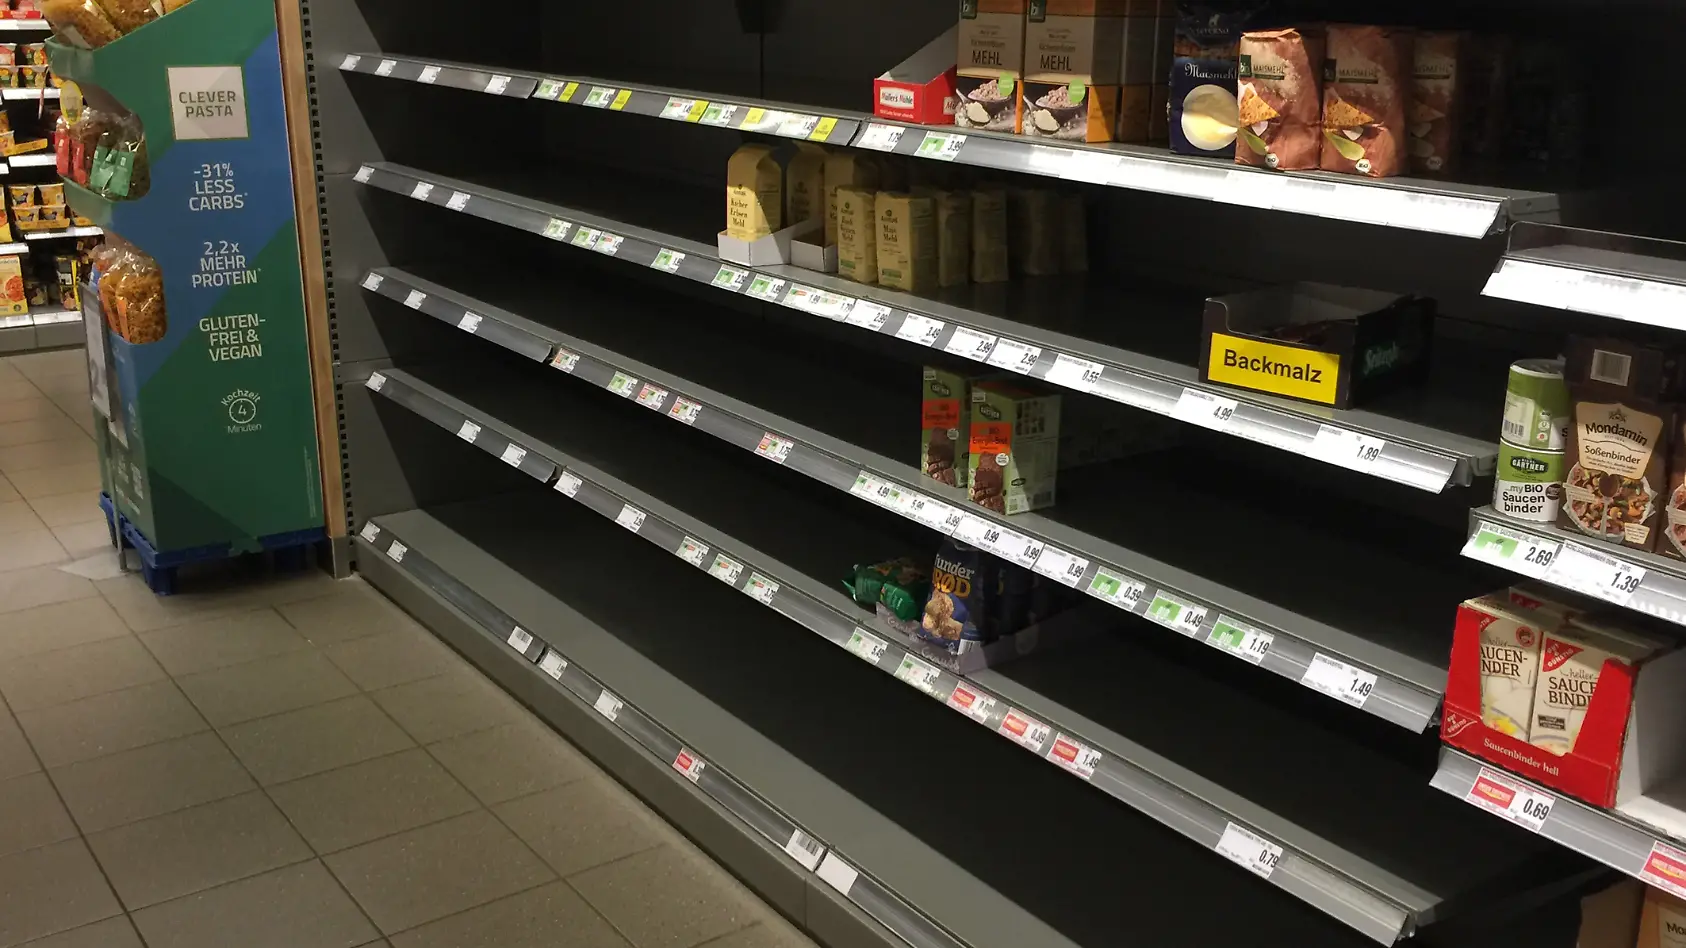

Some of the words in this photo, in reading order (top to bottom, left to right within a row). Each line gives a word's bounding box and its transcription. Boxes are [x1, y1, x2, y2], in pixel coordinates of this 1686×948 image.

[972, 50, 1002, 66] MEHL
[1040, 55, 1072, 71] MEHL
[179, 91, 236, 104] CLEVER
[185, 105, 234, 118] PASTA
[194, 162, 234, 178] -31%
[194, 179, 235, 194] LESS
[204, 241, 240, 258] 2,2x
[200, 256, 246, 272] MEHR
[199, 313, 266, 332] GLUTEN-
[209, 331, 243, 346] FREI
[246, 329, 259, 342] &
[208, 344, 262, 362] VEGAN
[976, 340, 992, 354] 2.99
[1020, 353, 1037, 366] 2.99
[1223, 348, 1322, 384] Backmalz
[1082, 370, 1100, 384] 0.55
[221, 388, 261, 407] Kochzeit
[238, 404, 247, 416] 4
[1213, 405, 1232, 421] 4.99
[227, 423, 262, 433] Minuten
[1585, 421, 1648, 447] Mondamin
[1357, 444, 1379, 462] 1.89
[1584, 445, 1641, 465] Soßenbinder
[1512, 458, 1545, 471] GÄRTNER
[1502, 491, 1545, 504] Saucen
[1504, 502, 1543, 514] binder
[984, 529, 999, 543] 0.99
[1024, 545, 1040, 560] 0.99
[1525, 546, 1553, 567] 2.69
[1067, 563, 1084, 578] 0.99
[1611, 571, 1639, 593] 1.39
[1124, 586, 1141, 602] 0.59
[1184, 611, 1203, 628] 0.49
[1249, 637, 1269, 655] 1.19
[1482, 661, 1520, 677] NDER
[1570, 668, 1594, 680] heller
[1350, 678, 1372, 697] 1.49
[1483, 738, 1541, 769] Saucenbinder
[1543, 761, 1559, 777] hell
[1523, 798, 1550, 821] 0.69
[1259, 849, 1279, 868] 0.79
